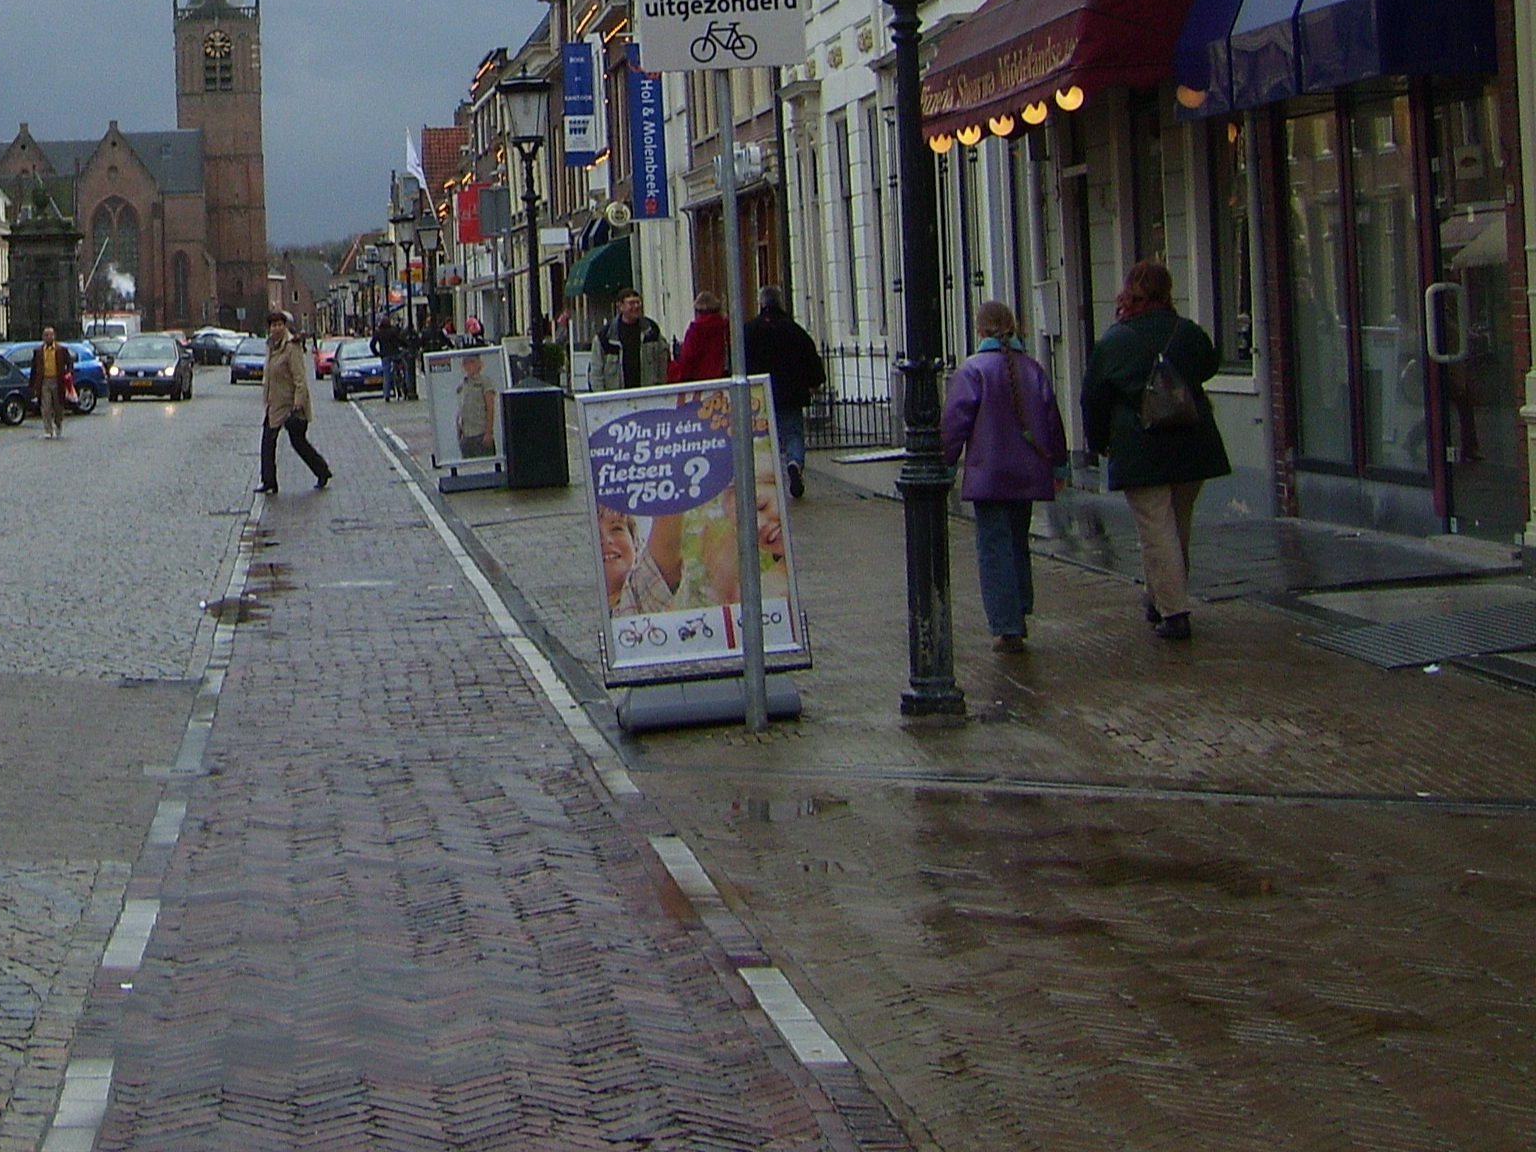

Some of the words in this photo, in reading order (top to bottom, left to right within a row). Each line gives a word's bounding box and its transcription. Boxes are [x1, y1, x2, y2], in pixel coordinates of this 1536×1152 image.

[640, 79, 655, 104] Hol
[642, 107, 655, 117] &
[643, 122, 660, 198] Molenbeek
[608, 420, 652, 443] Win
[655, 421, 671, 440] jij
[675, 419, 702, 434] één
[590, 447, 615, 457] van
[613, 449, 631, 462] de
[633, 440, 651, 464] 5
[654, 438, 726, 460] gepimpte
[598, 463, 673, 487] fietsen
